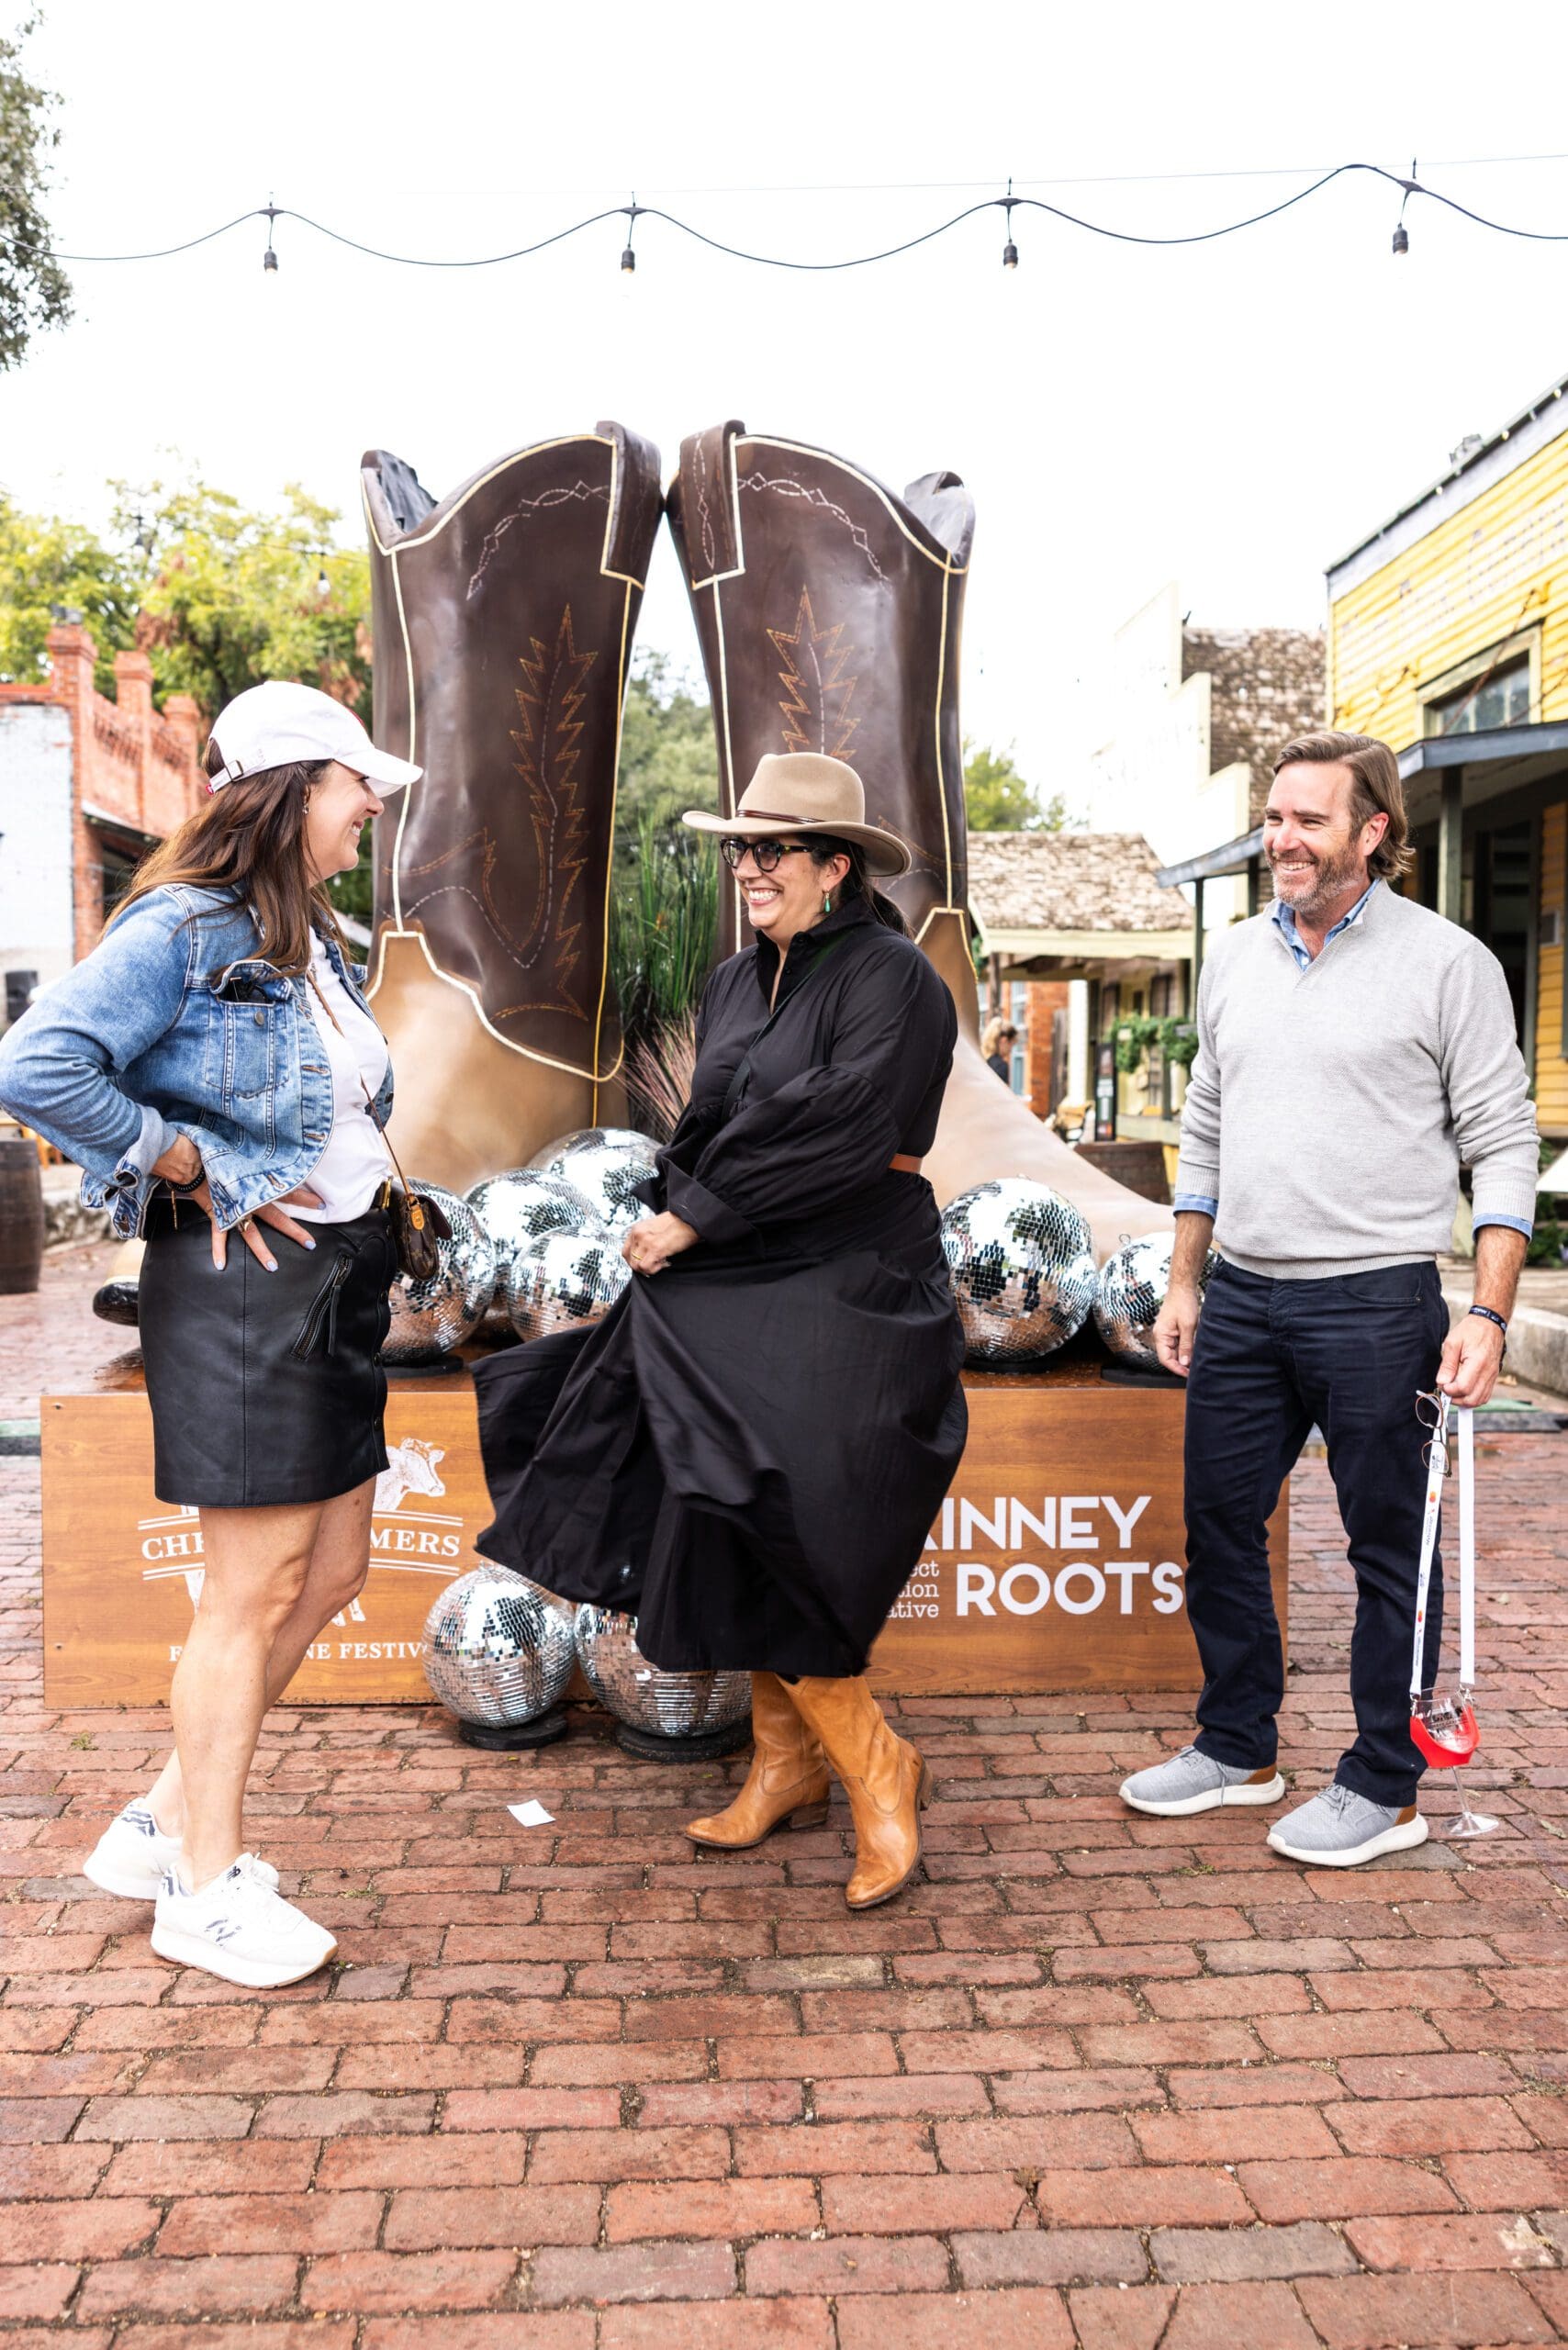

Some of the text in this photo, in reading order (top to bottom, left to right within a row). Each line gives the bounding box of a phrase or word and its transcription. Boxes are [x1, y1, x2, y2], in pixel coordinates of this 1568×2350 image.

[924, 1496, 1152, 1550] INNEY
[957, 1562, 1184, 1617] ROOTS
[339, 1642, 427, 1659] FESTIV
